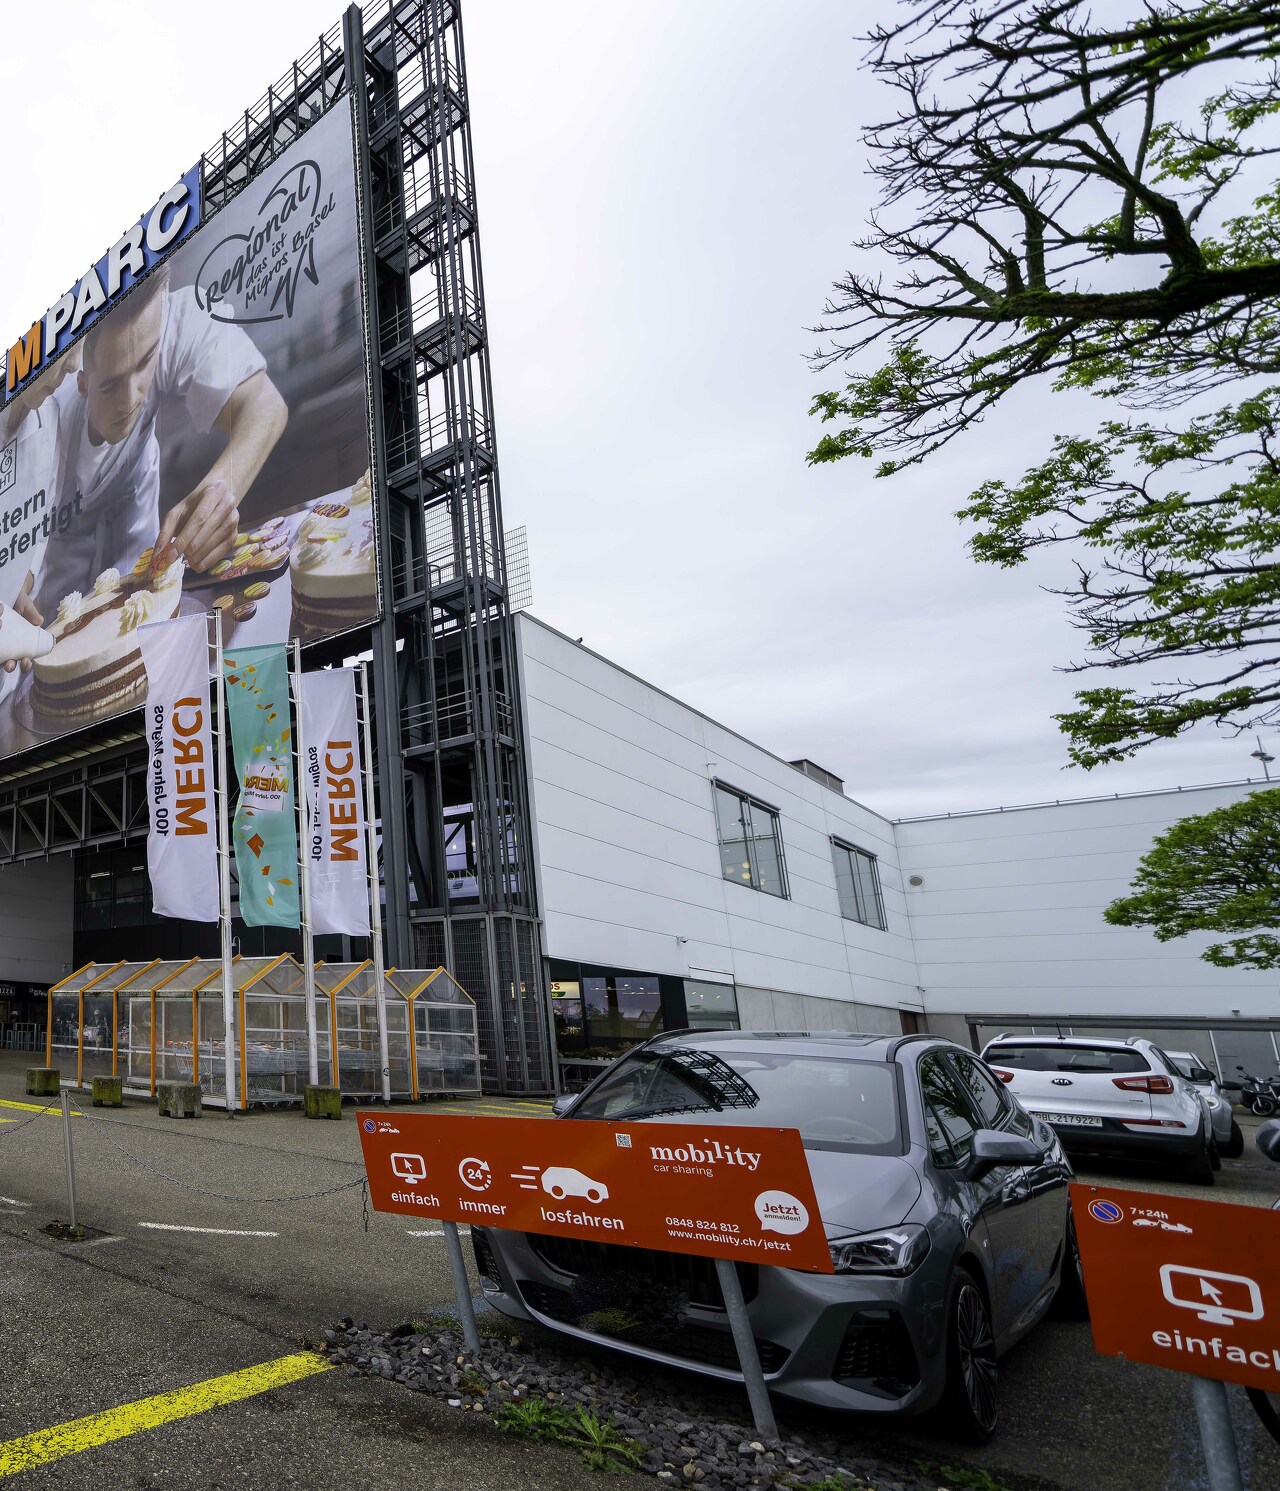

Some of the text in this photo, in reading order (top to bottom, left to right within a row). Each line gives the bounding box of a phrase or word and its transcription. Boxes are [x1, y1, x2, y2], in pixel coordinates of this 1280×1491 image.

[205, 167, 312, 313] Regional
[245, 192, 337, 309] Migros Basel
[246, 231, 288, 288] das ist
[7, 183, 190, 391] MPARC
[649, 1138, 761, 1171] mobility
[467, 1168, 483, 1180] 24
[653, 1164, 714, 1178] car sharing
[391, 1190, 440, 1207] einfach
[458, 1197, 507, 1216] immer
[762, 1202, 800, 1216] Jetzt
[540, 1206, 625, 1231] losfahren
[665, 1216, 741, 1233] 0848 824 812
[763, 1213, 802, 1222] anmelden!
[667, 1228, 793, 1251] www.mobility.ch/jetzt
